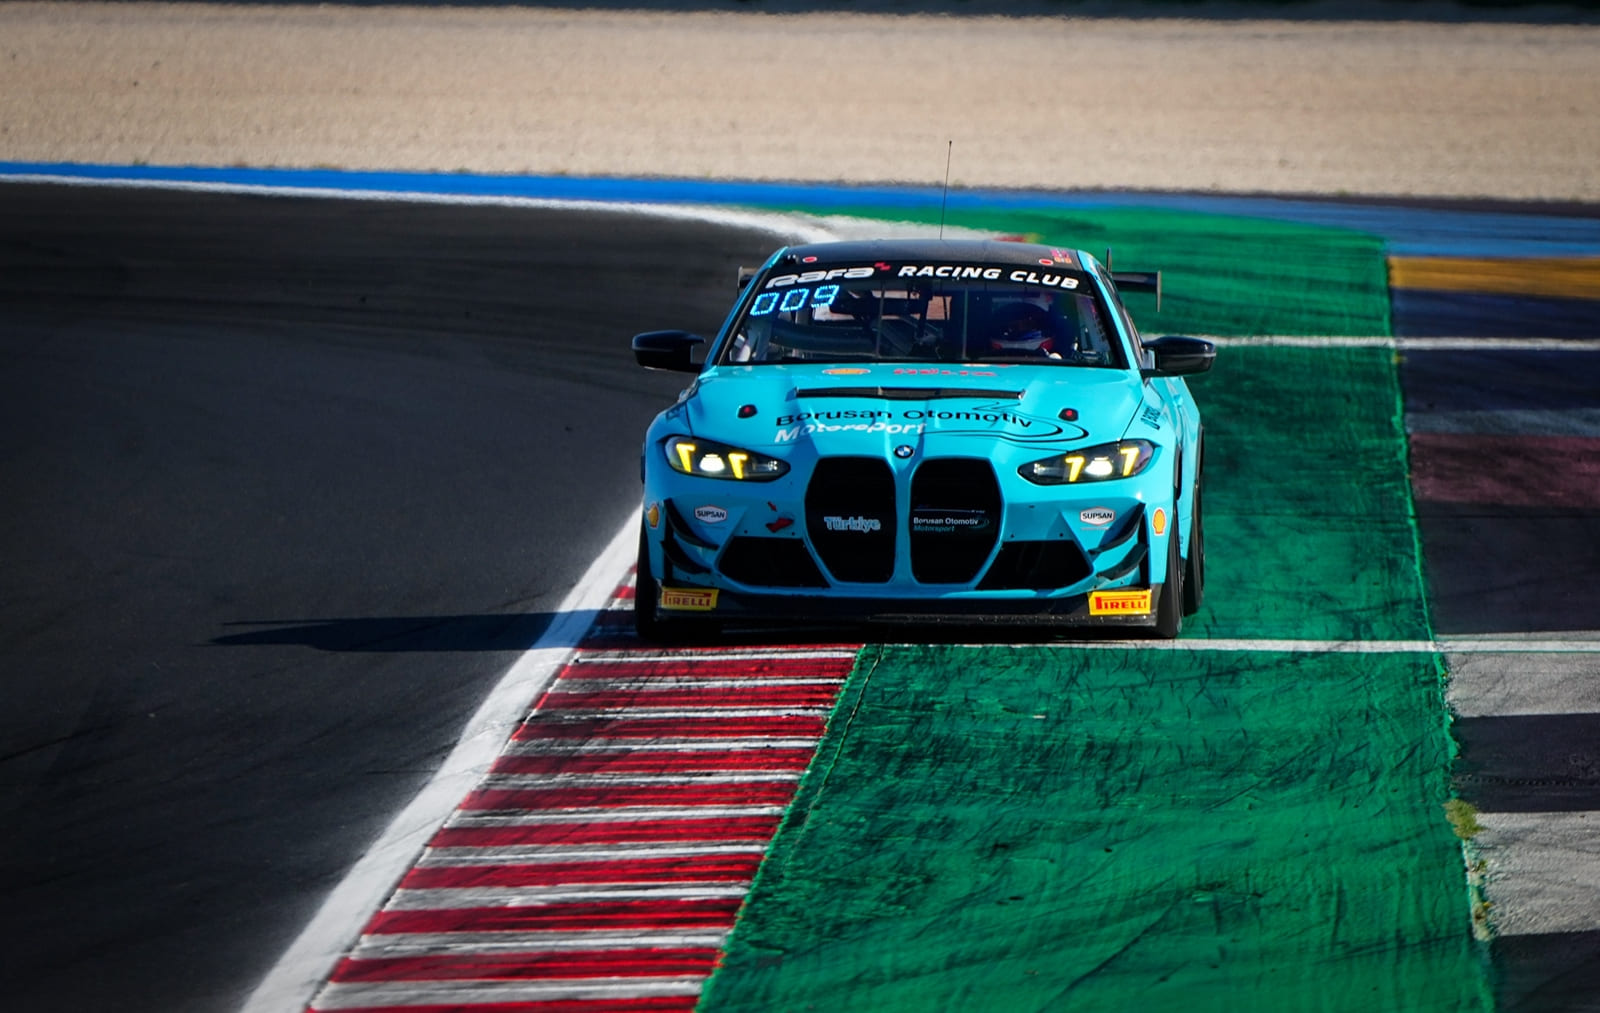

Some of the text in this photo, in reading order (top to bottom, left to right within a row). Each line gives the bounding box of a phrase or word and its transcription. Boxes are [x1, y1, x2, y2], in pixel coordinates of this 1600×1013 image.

[897, 265, 1079, 290] RACING CLUB
[750, 284, 840, 316] 009
[776, 410, 1032, 428] Borusan Otomotiv
[774, 421, 926, 443] Motorsport
[697, 510, 725, 519] SUPSAN
[913, 517, 979, 525] Borusan Otomotiv
[1082, 511, 1113, 520] SUPSAN
[823, 516, 882, 534] Türkiye
[663, 591, 712, 607] PIRELLI
[1094, 595, 1148, 610] PIRELLI
